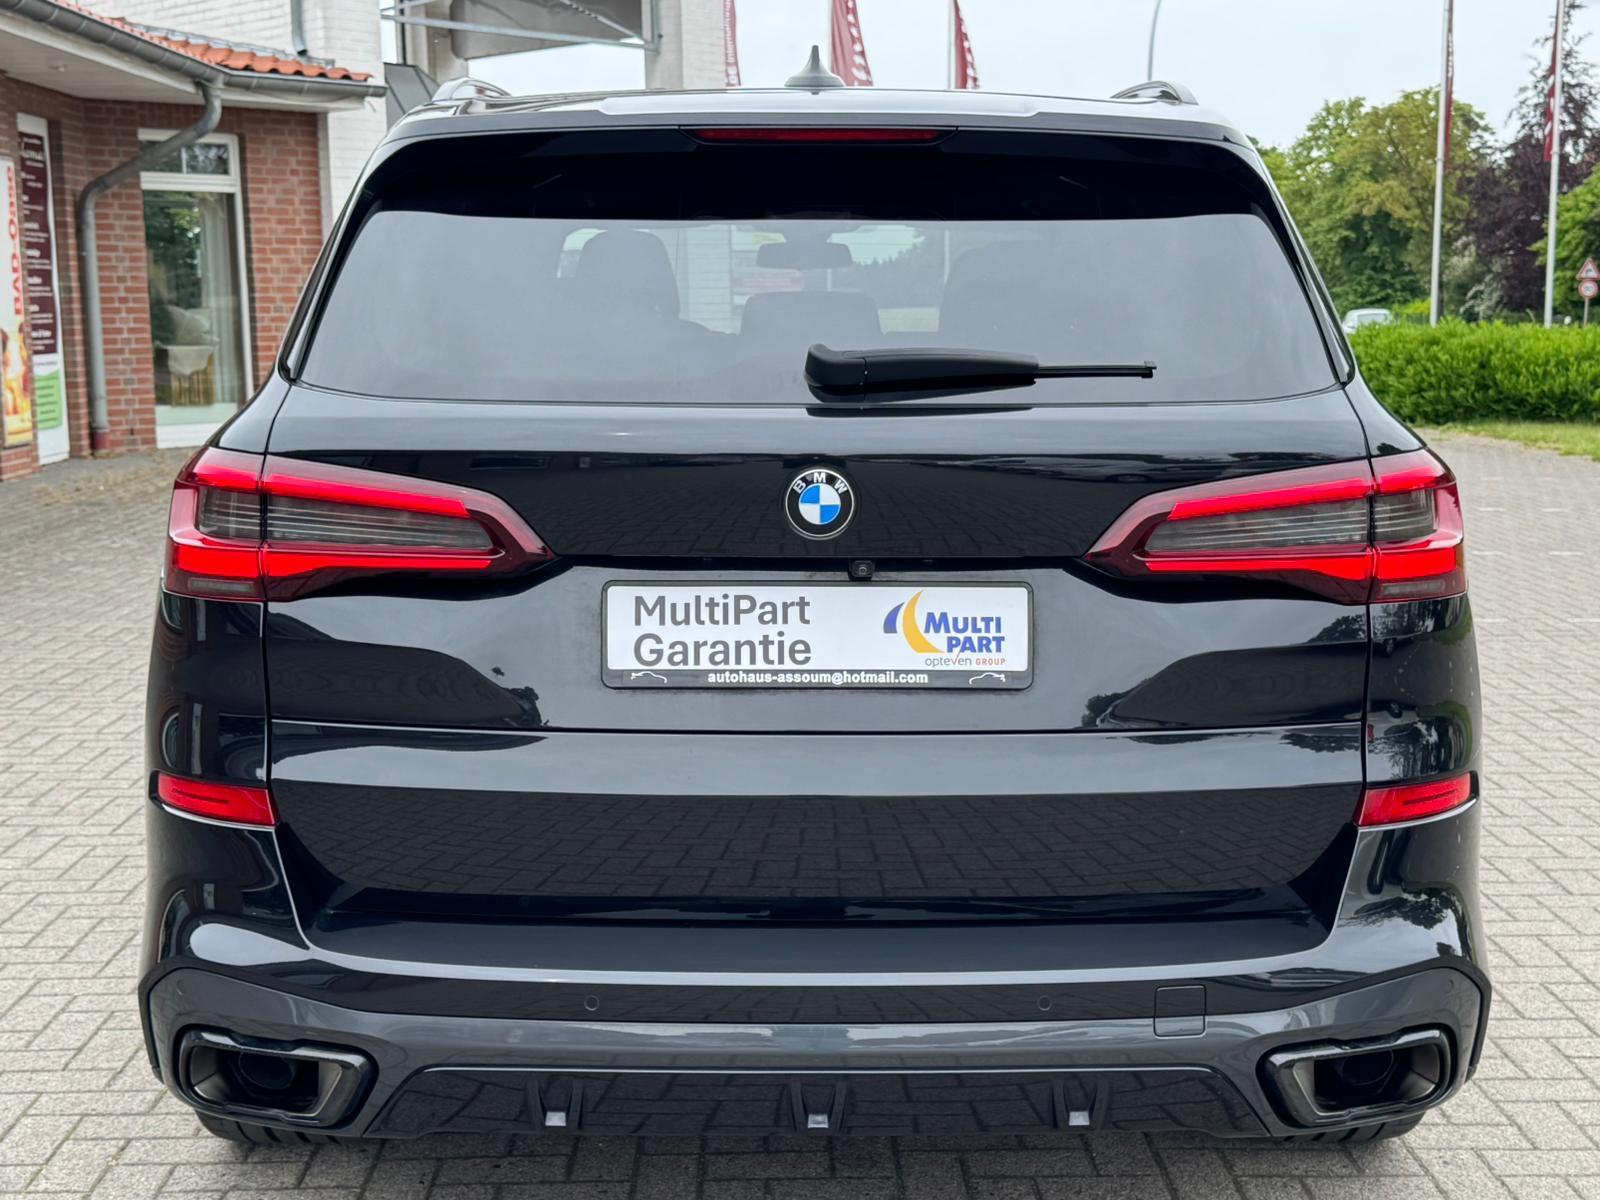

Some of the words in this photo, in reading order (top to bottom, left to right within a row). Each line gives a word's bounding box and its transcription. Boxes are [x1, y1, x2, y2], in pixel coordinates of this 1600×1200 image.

[793, 472, 847, 494] BMW
[634, 593, 811, 626] MultiPart
[924, 612, 1001, 633] MULTI
[634, 631, 811, 667] Garantie
[947, 636, 1005, 653] PART
[925, 656, 972, 668] opteven
[975, 658, 1006, 666] GROUP
[707, 671, 929, 685] autohaus-assoum@hotmail.com
